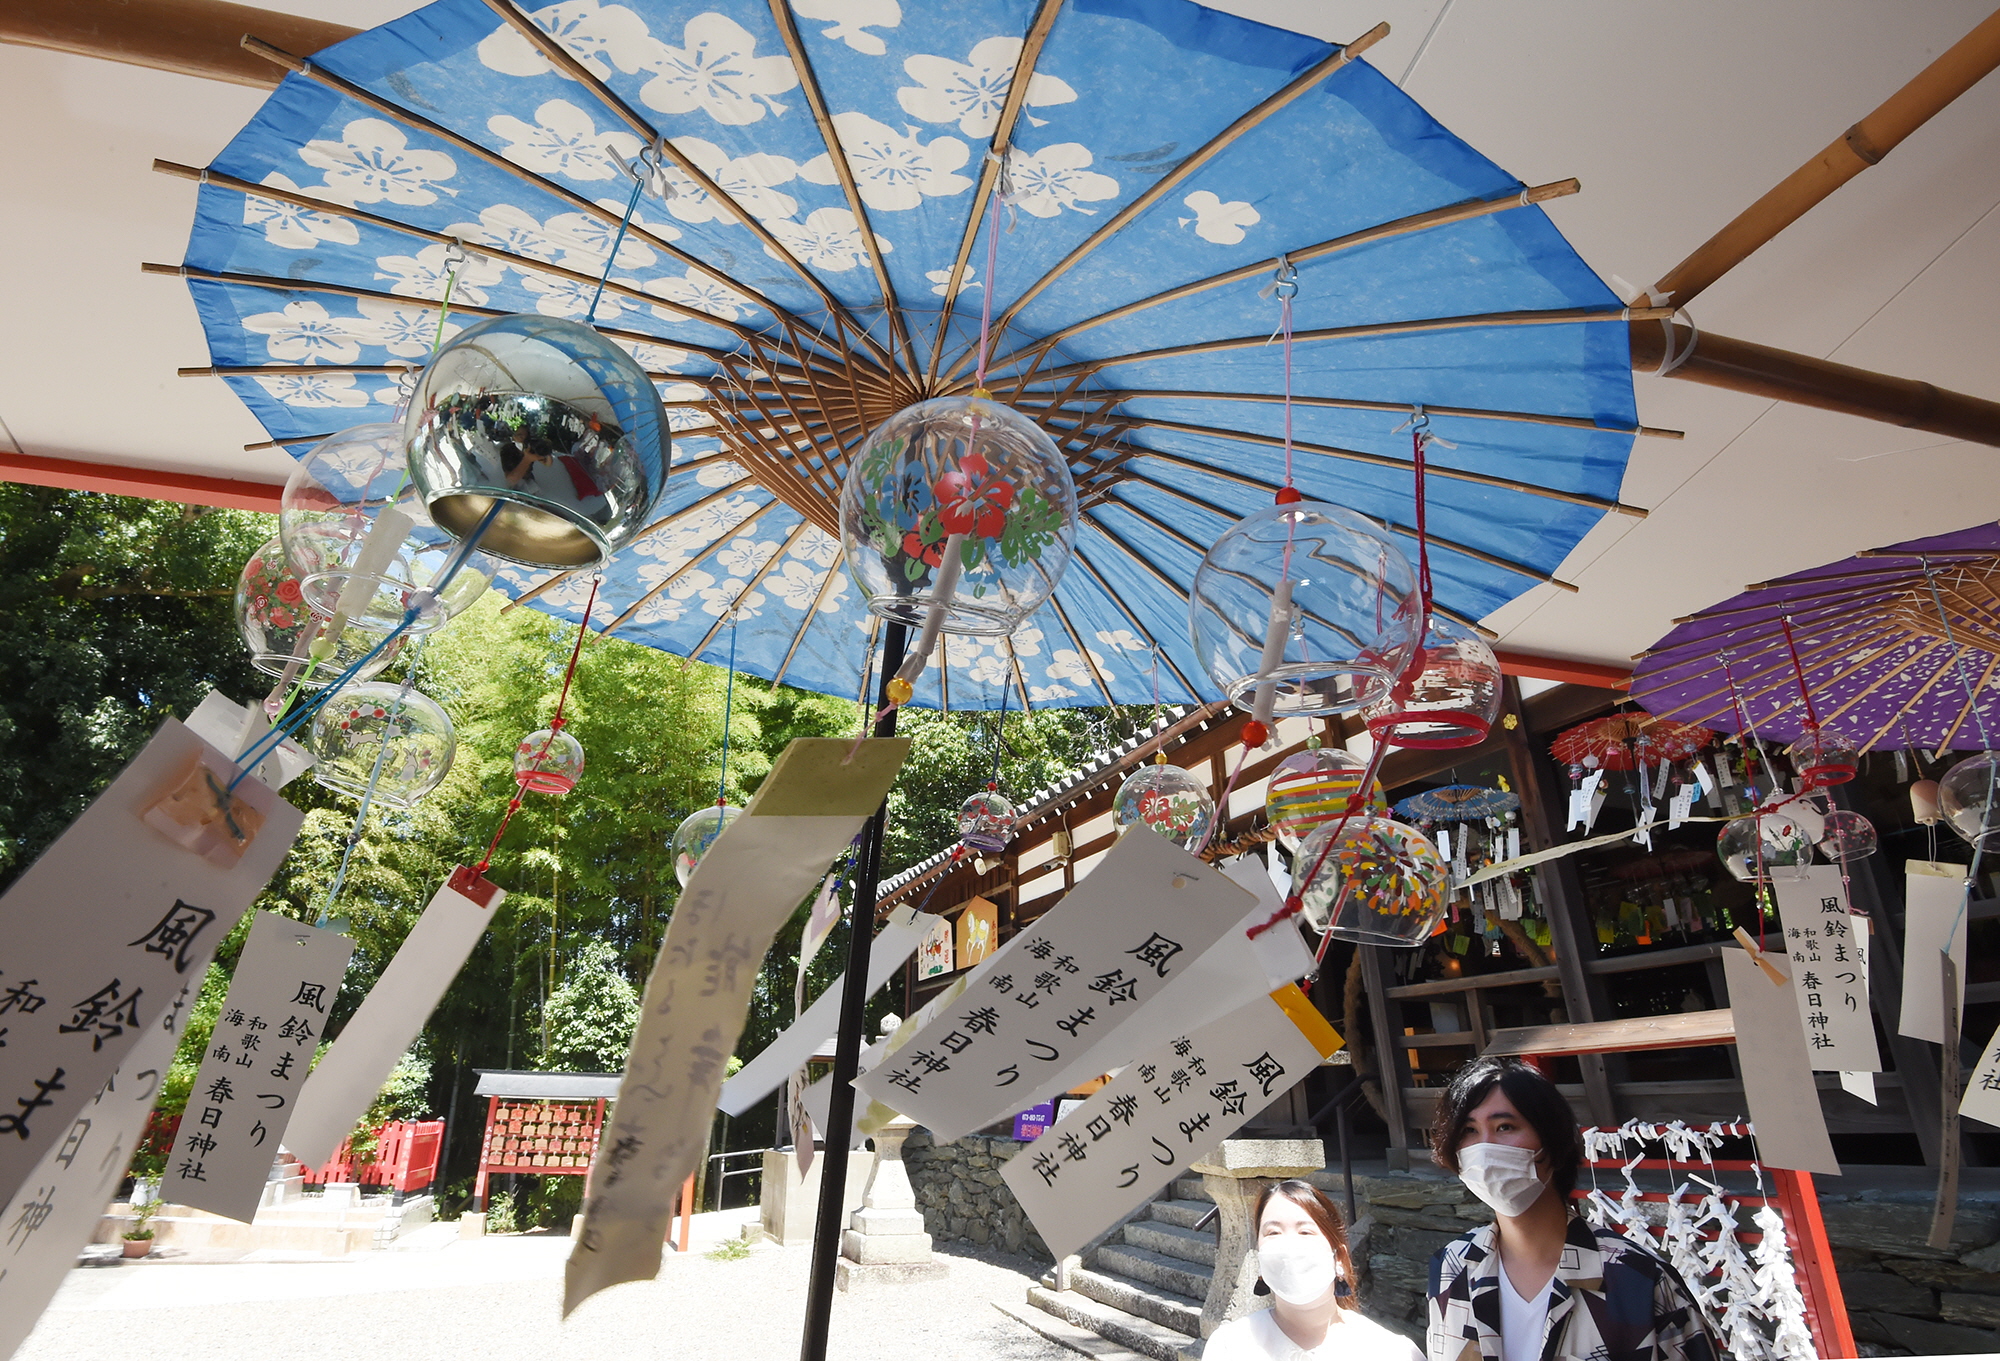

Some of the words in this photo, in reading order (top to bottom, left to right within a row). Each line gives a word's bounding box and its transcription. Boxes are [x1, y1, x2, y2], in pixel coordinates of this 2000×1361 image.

[989, 937, 1051, 994] 海南
[1787, 927, 1805, 963] 海南
[1803, 927, 1821, 963] 和歌山
[1820, 897, 1857, 1013] 風鈴まつり
[995, 932, 1184, 1088] 風鈴まつり
[1015, 952, 1080, 1010] 和歌山
[1802, 970, 1835, 1049] 春日神社
[212, 1008, 243, 1063] 海南
[235, 1015, 268, 1070] 和歌山
[249, 980, 326, 1148] 風鈴まつり
[885, 1006, 999, 1095] 春日神社
[1138, 1035, 1193, 1084] 海南
[1153, 1057, 1207, 1105] 和歌山
[178, 1075, 234, 1183] 春日神社
[1032, 1094, 1139, 1189] 春日神社
[1115, 1052, 1286, 1189] 風鈴まつり
